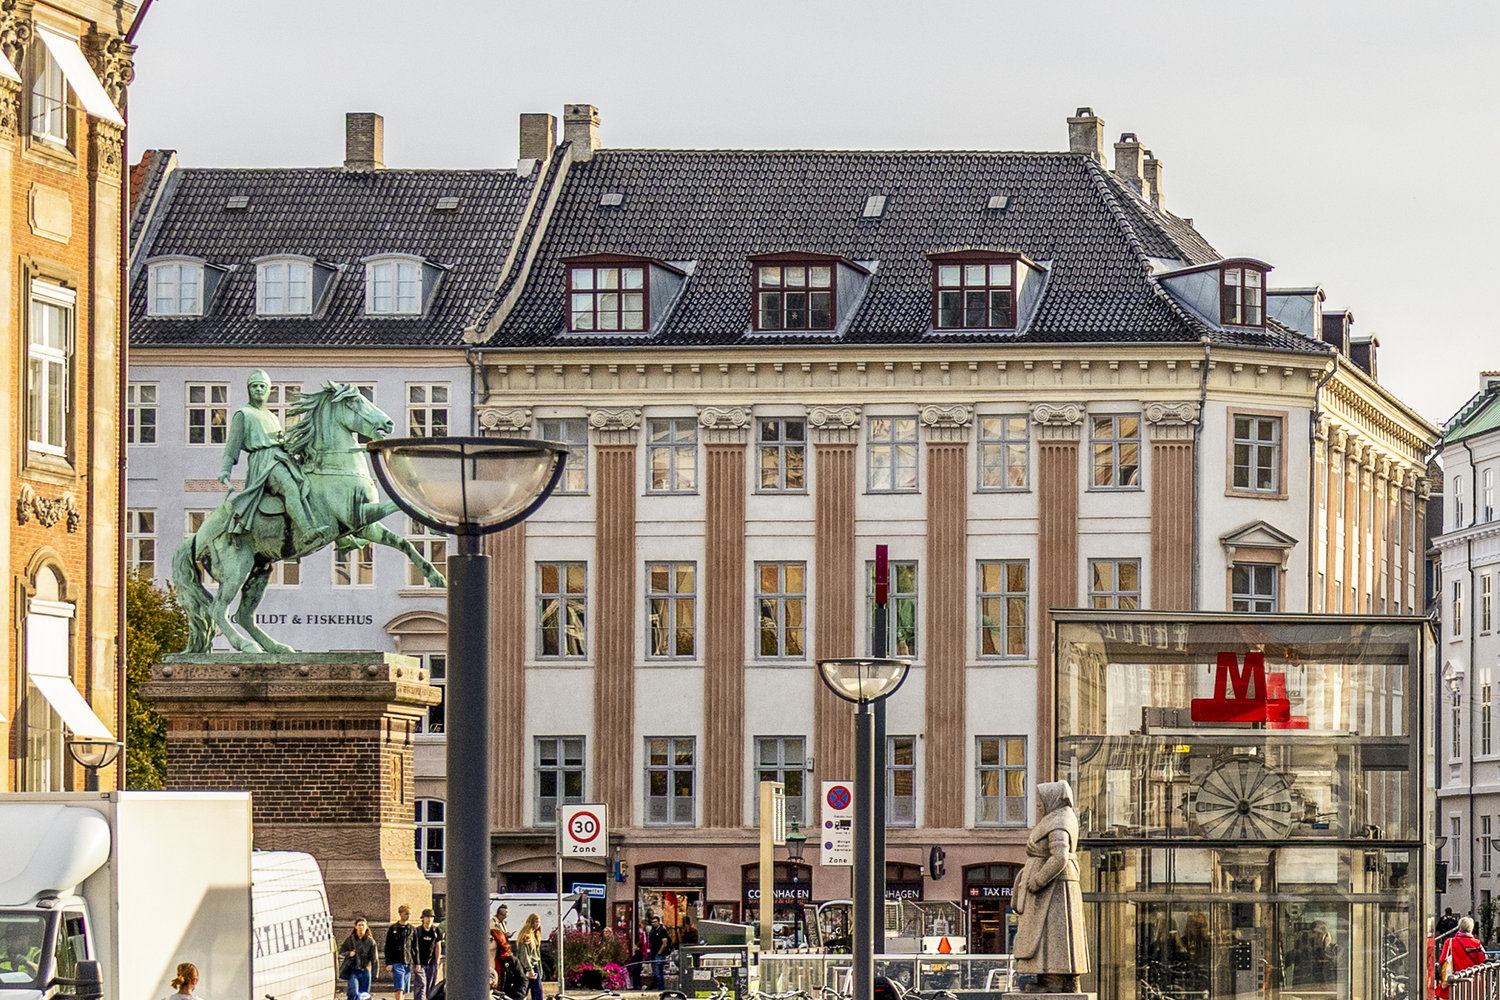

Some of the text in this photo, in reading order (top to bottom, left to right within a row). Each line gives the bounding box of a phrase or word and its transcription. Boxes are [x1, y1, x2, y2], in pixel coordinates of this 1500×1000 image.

[228, 614, 373, 625] CILDT & FISKEHUS
[1214, 651, 1267, 699] M
[574, 821, 594, 834] 30
[572, 845, 597, 853] Zone
[747, 889, 809, 899] CONHAEN
[983, 887, 1014, 897] TAX FRE
[254, 918, 307, 959] XTILIA
